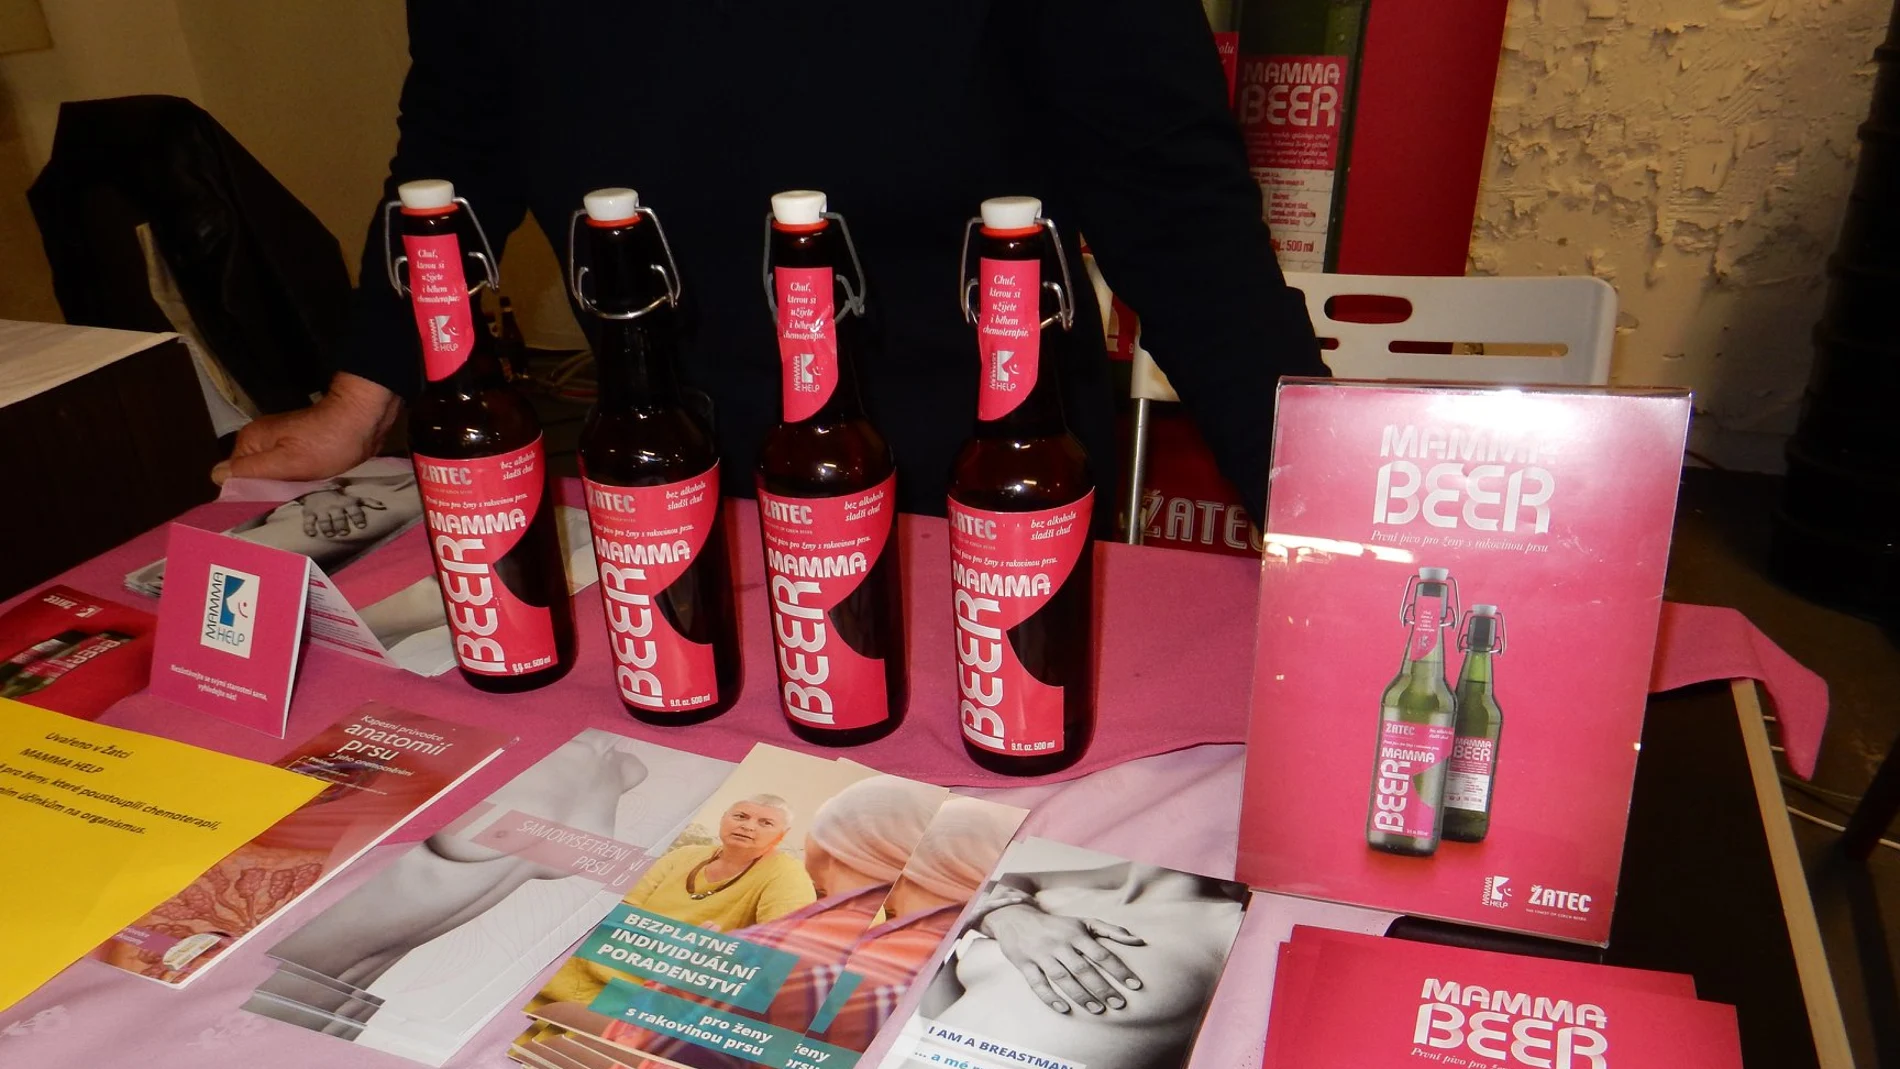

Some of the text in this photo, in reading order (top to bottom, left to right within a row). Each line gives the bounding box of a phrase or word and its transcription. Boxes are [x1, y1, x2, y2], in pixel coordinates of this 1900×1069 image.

[1243, 62, 1340, 85] MAMMA
[1240, 84, 1338, 127] BEER
[989, 287, 1021, 299] kterou si
[801, 383, 820, 393] HELP
[996, 382, 1017, 392] HELP
[665, 490, 679, 500] bez
[844, 500, 857, 511] bez
[1372, 460, 1556, 534] BEER
[428, 508, 526, 535] MAMMA
[1030, 518, 1045, 529] bez
[595, 536, 691, 565] MAMMA
[1371, 529, 1397, 543] První
[1399, 533, 1421, 546] pivo
[1422, 536, 1440, 547] pro
[1441, 535, 1465, 549] ženy
[1475, 537, 1524, 551] rakovinou
[1524, 541, 1549, 554] prsu
[768, 548, 867, 578] MAMMA
[983, 556, 999, 568] ženy
[952, 559, 1051, 598] MAMMA
[205, 571, 224, 640] MAMMA
[435, 535, 507, 672] BEER
[217, 627, 246, 648] HELP
[601, 562, 665, 707] BEER
[772, 574, 836, 725] BEER
[955, 588, 1005, 750] BEER
[45, 732, 93, 750] Uvařeno
[344, 723, 454, 757] anatomií
[360, 714, 444, 742] Kapesní průvodce
[337, 740, 400, 762] prsu
[1033, 741, 1047, 751] 500
[1381, 747, 1436, 764] MAMMA
[1453, 745, 1491, 762] BEER
[1455, 737, 1492, 749] MAMMA
[19, 748, 105, 774] MAMMA HELP
[0, 766, 24, 776] pro
[50, 778, 86, 793] které
[1374, 759, 1412, 833] BEER
[17, 792, 147, 836] účinkům na organismus.
[517, 819, 636, 862] SAMOVYŠETŘENÍ
[571, 855, 616, 876] PRSU
[1489, 900, 1509, 909] HELP
[1528, 884, 1592, 913] ŽATEC
[624, 913, 741, 956] BEZPLATNÉ
[610, 928, 761, 981] INDIVIDUÁLNÍ
[597, 943, 747, 997] PORADENSTVÍ
[1420, 977, 1608, 1029] MAMMA
[625, 1007, 764, 1056] s rakovinou prsu
[700, 1015, 774, 1044] pro ženy
[928, 1026, 936, 1035] I
[937, 1028, 963, 1043] AM
[964, 1037, 976, 1048] A
[1413, 1002, 1608, 1069] BEER
[931, 1053, 941, 1062] a
[1410, 1046, 1441, 1061] První
[1442, 1054, 1467, 1066] pivo
[1467, 1059, 1487, 1069] pro
